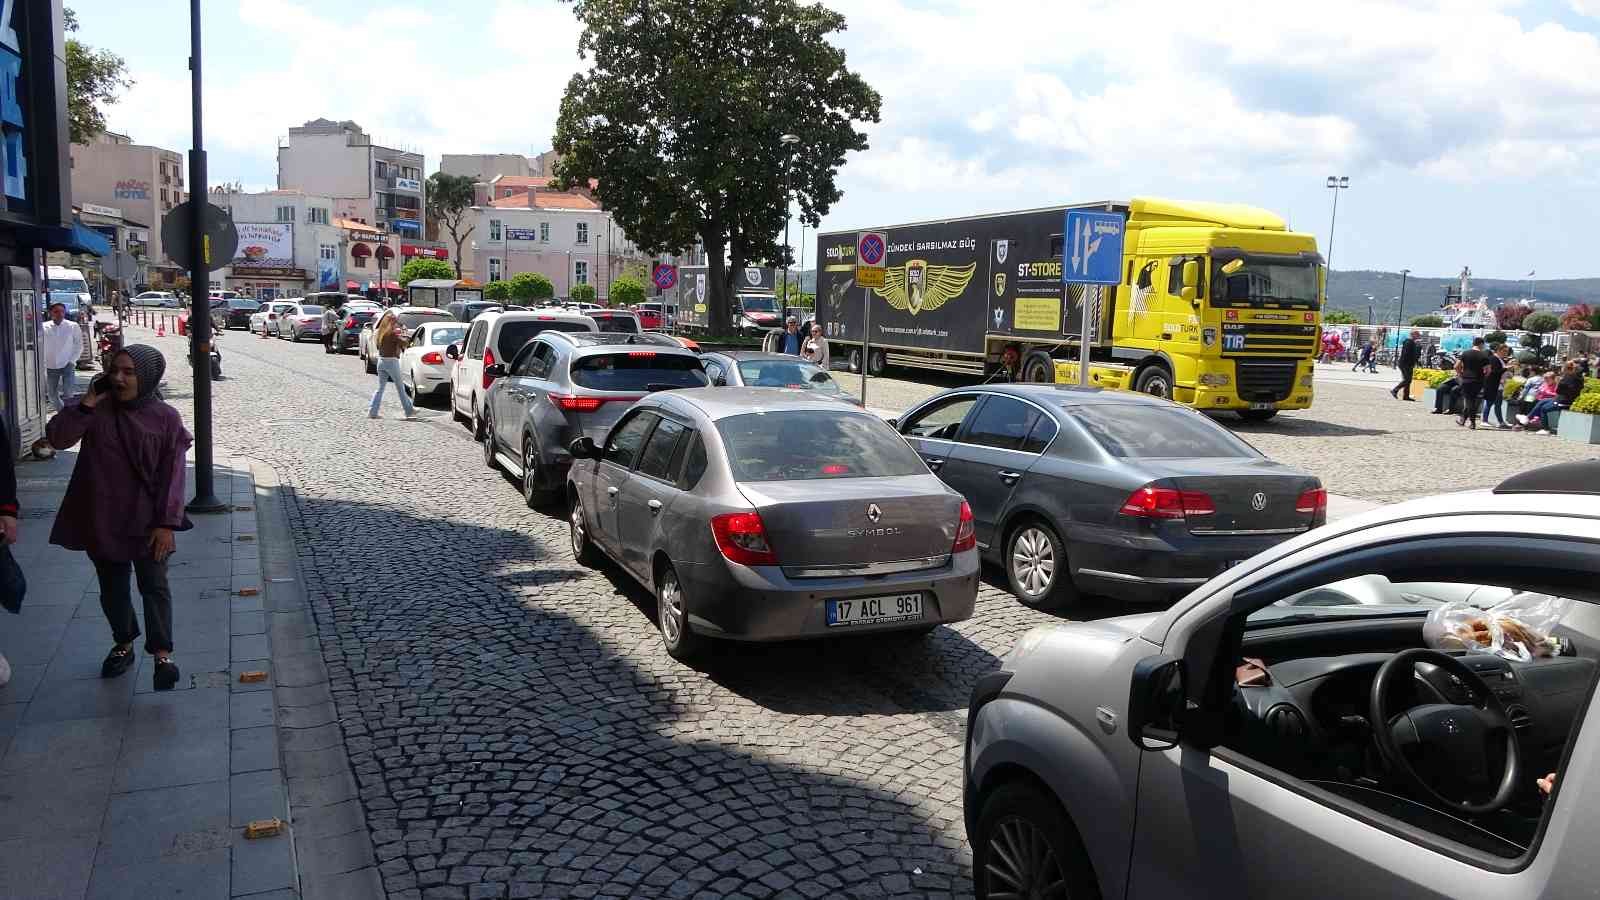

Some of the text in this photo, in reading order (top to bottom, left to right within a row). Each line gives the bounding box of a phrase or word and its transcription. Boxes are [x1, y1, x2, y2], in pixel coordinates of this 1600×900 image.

[114, 178, 151, 190] ANZAC
[112, 190, 151, 201] HOTEL
[916, 240, 957, 251] SARSILMAZ
[959, 237, 976, 251] GÜÇ
[1224, 335, 1245, 349] TIR
[847, 527, 902, 537] SYMBOL
[838, 601, 852, 619] 17
[861, 599, 886, 617] ACL
[896, 596, 919, 614] 961
